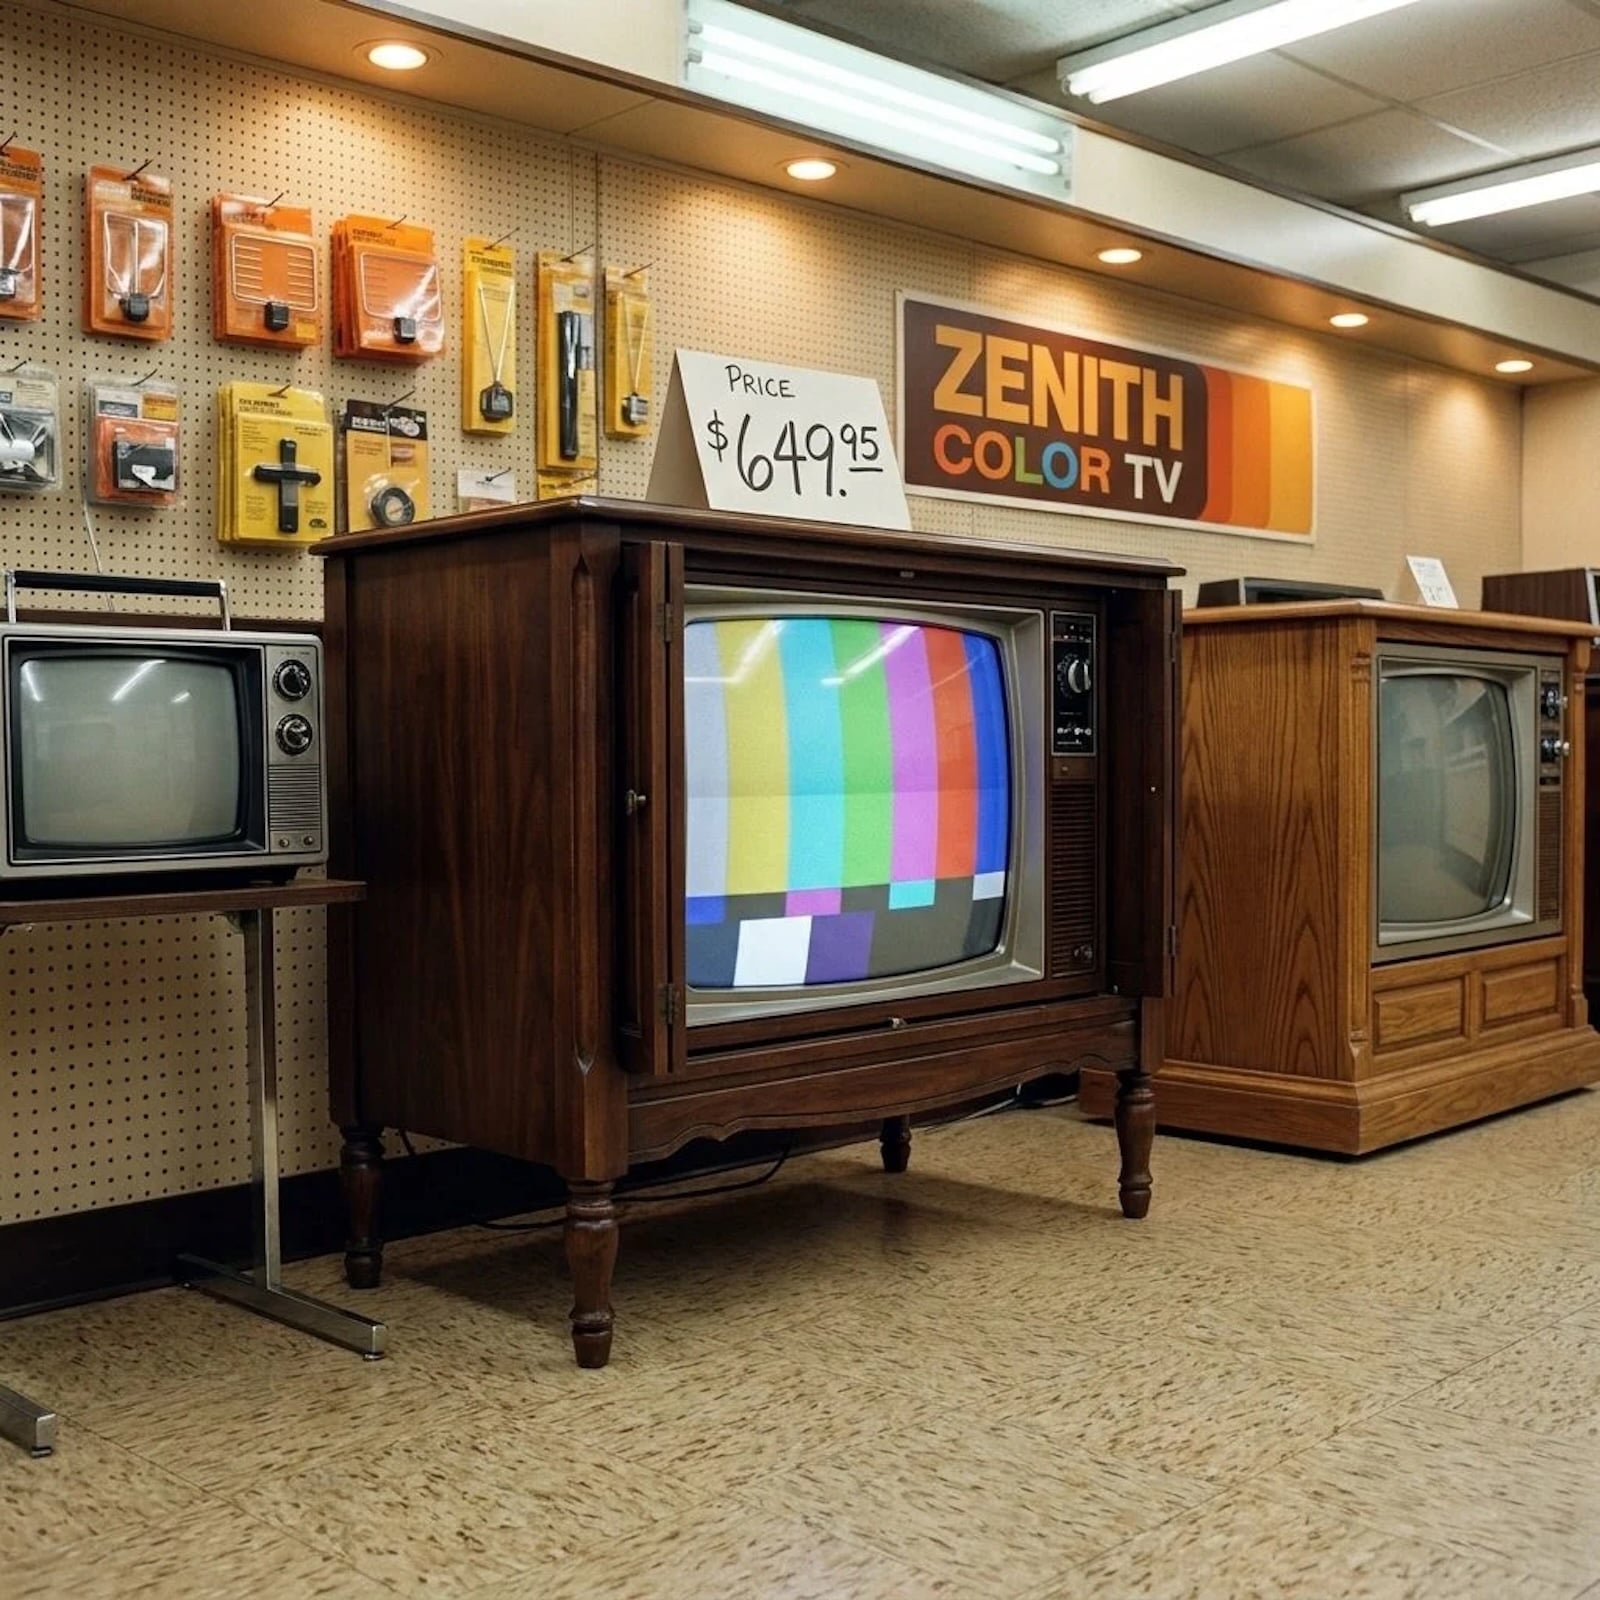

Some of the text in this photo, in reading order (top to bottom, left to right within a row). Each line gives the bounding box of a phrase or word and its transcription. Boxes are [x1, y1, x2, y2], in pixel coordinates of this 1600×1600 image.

[725, 364, 796, 398] PRICE
[933, 324, 1184, 451] ZENITH
[933, 424, 1183, 503] COLOR TV
